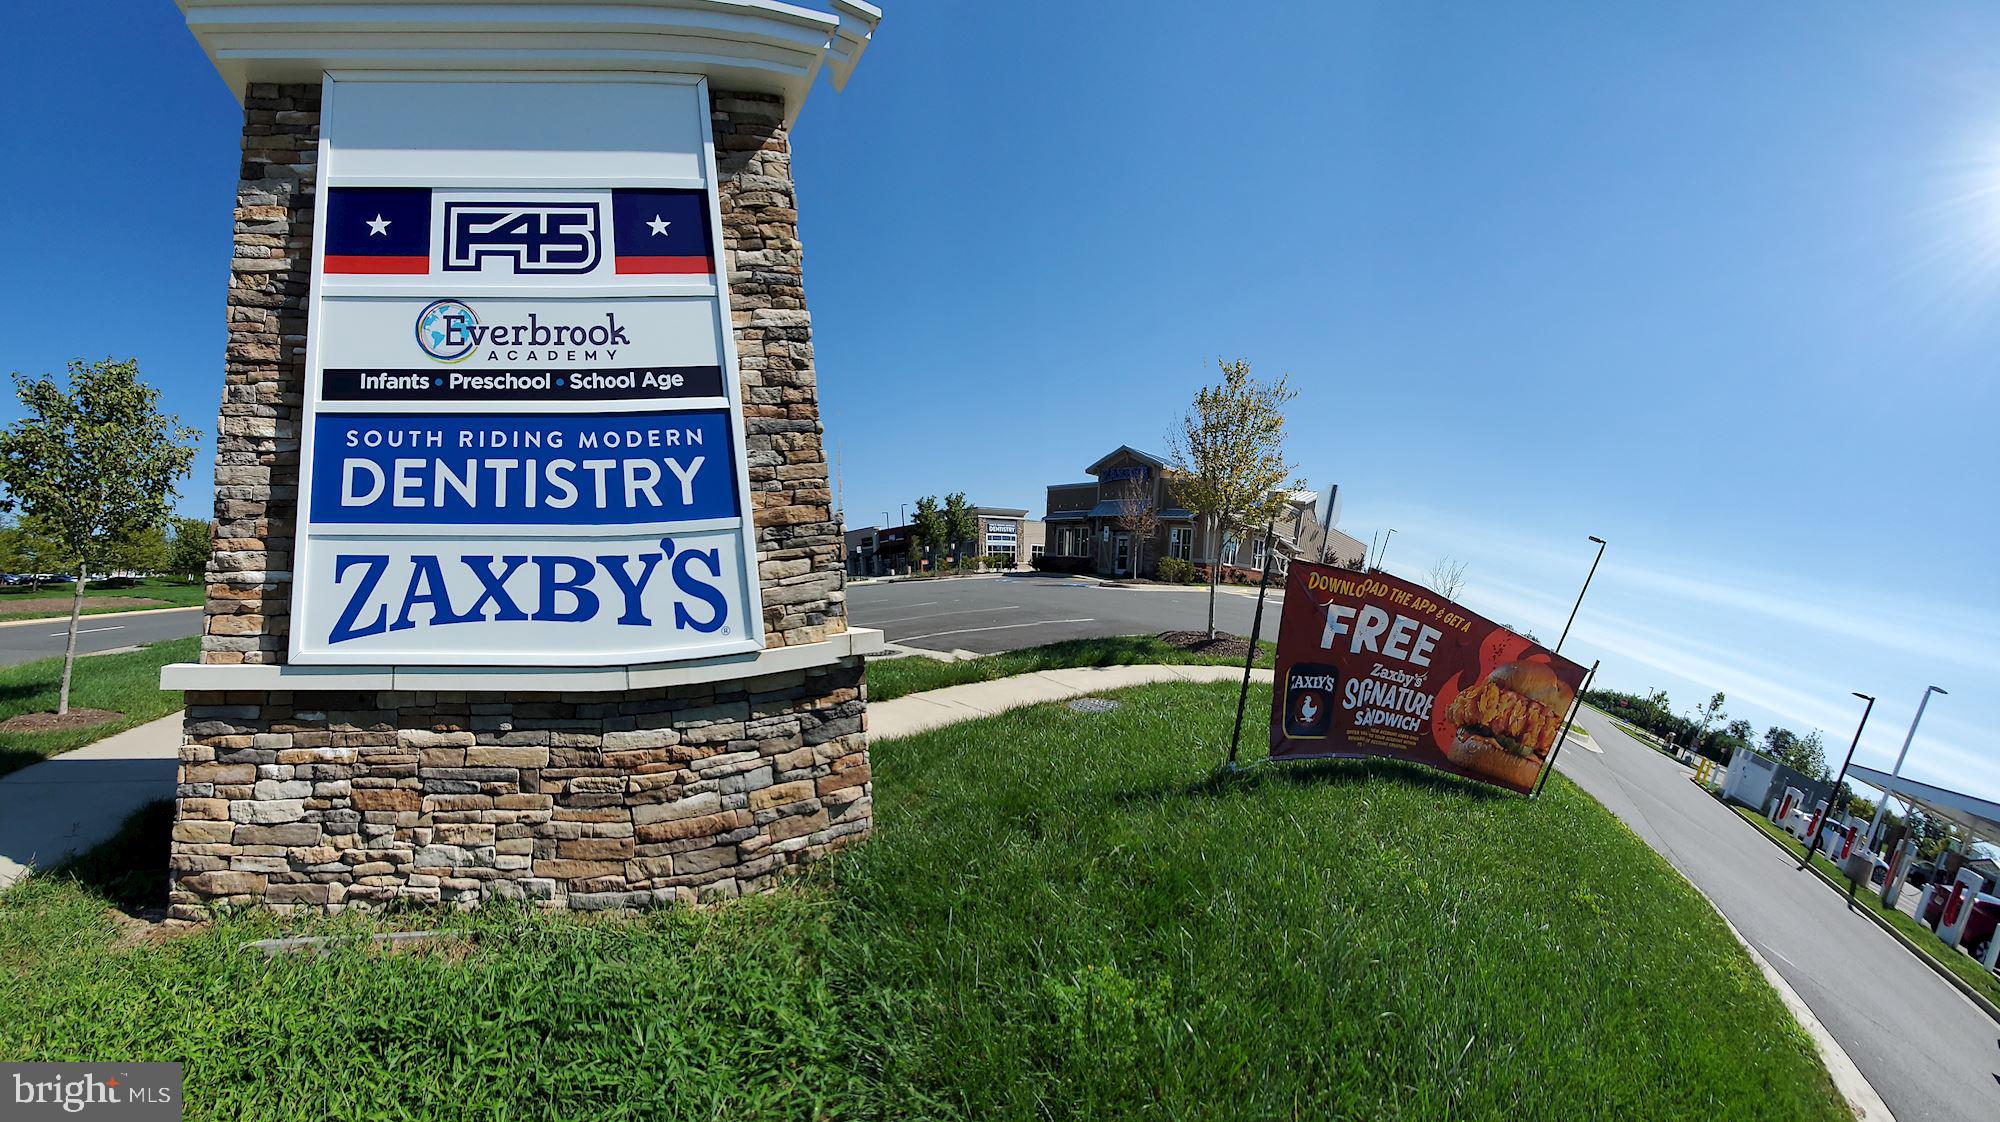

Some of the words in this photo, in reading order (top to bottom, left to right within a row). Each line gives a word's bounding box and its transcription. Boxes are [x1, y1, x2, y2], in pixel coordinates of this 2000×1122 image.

[443, 202, 601, 275] F45
[442, 313, 631, 347] Everbrook
[487, 350, 618, 362] ACADEMY
[359, 372, 430, 391] Infants
[449, 372, 551, 391] Preschool
[569, 372, 636, 390] School
[641, 372, 684, 390] Age
[345, 430, 443, 449] SOUTH
[459, 429, 564, 449] RIDING
[578, 428, 704, 449] MODERN
[340, 456, 706, 509] DENTISTRY
[328, 537, 729, 645] ZAXBY'S
[1307, 571, 1389, 598] DOWNLOAD
[1389, 587, 1413, 606] THE
[1411, 596, 1437, 615] APP
[1443, 612, 1465, 629] GET
[1460, 621, 1472, 633] A
[1320, 603, 1443, 668] FREE
